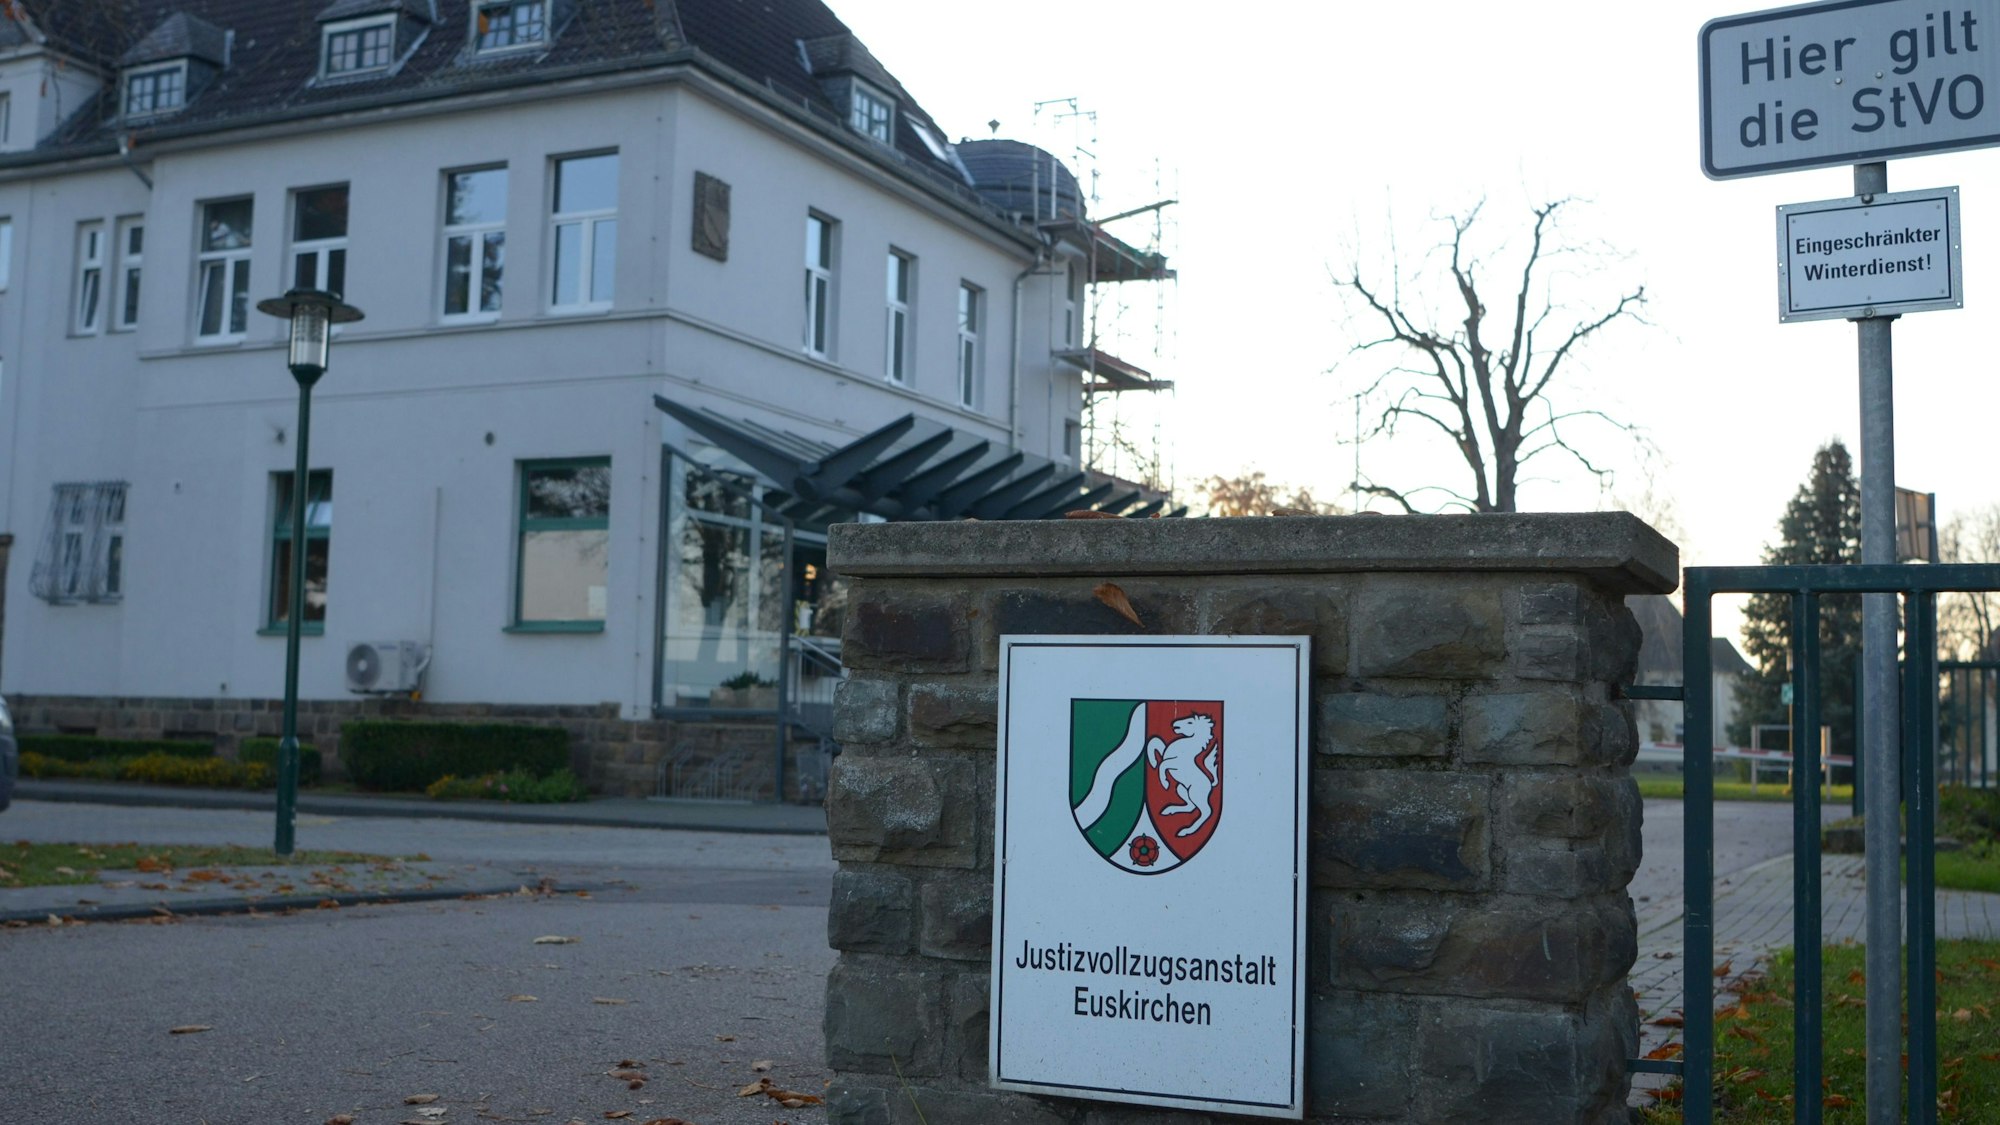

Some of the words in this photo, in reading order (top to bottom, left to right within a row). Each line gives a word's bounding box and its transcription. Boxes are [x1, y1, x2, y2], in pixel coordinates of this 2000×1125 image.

[1741, 35, 1857, 85] Hier
[1890, 10, 1979, 75] gilt
[1740, 100, 1819, 148] die
[1851, 74, 1985, 133] StVO
[1796, 227, 1941, 256] Eingeschränkter
[1804, 253, 1932, 282] Winterdienst!
[1016, 939, 1277, 986] Justizvollzugsanstalt
[1074, 986, 1212, 1026] Euskirchen
